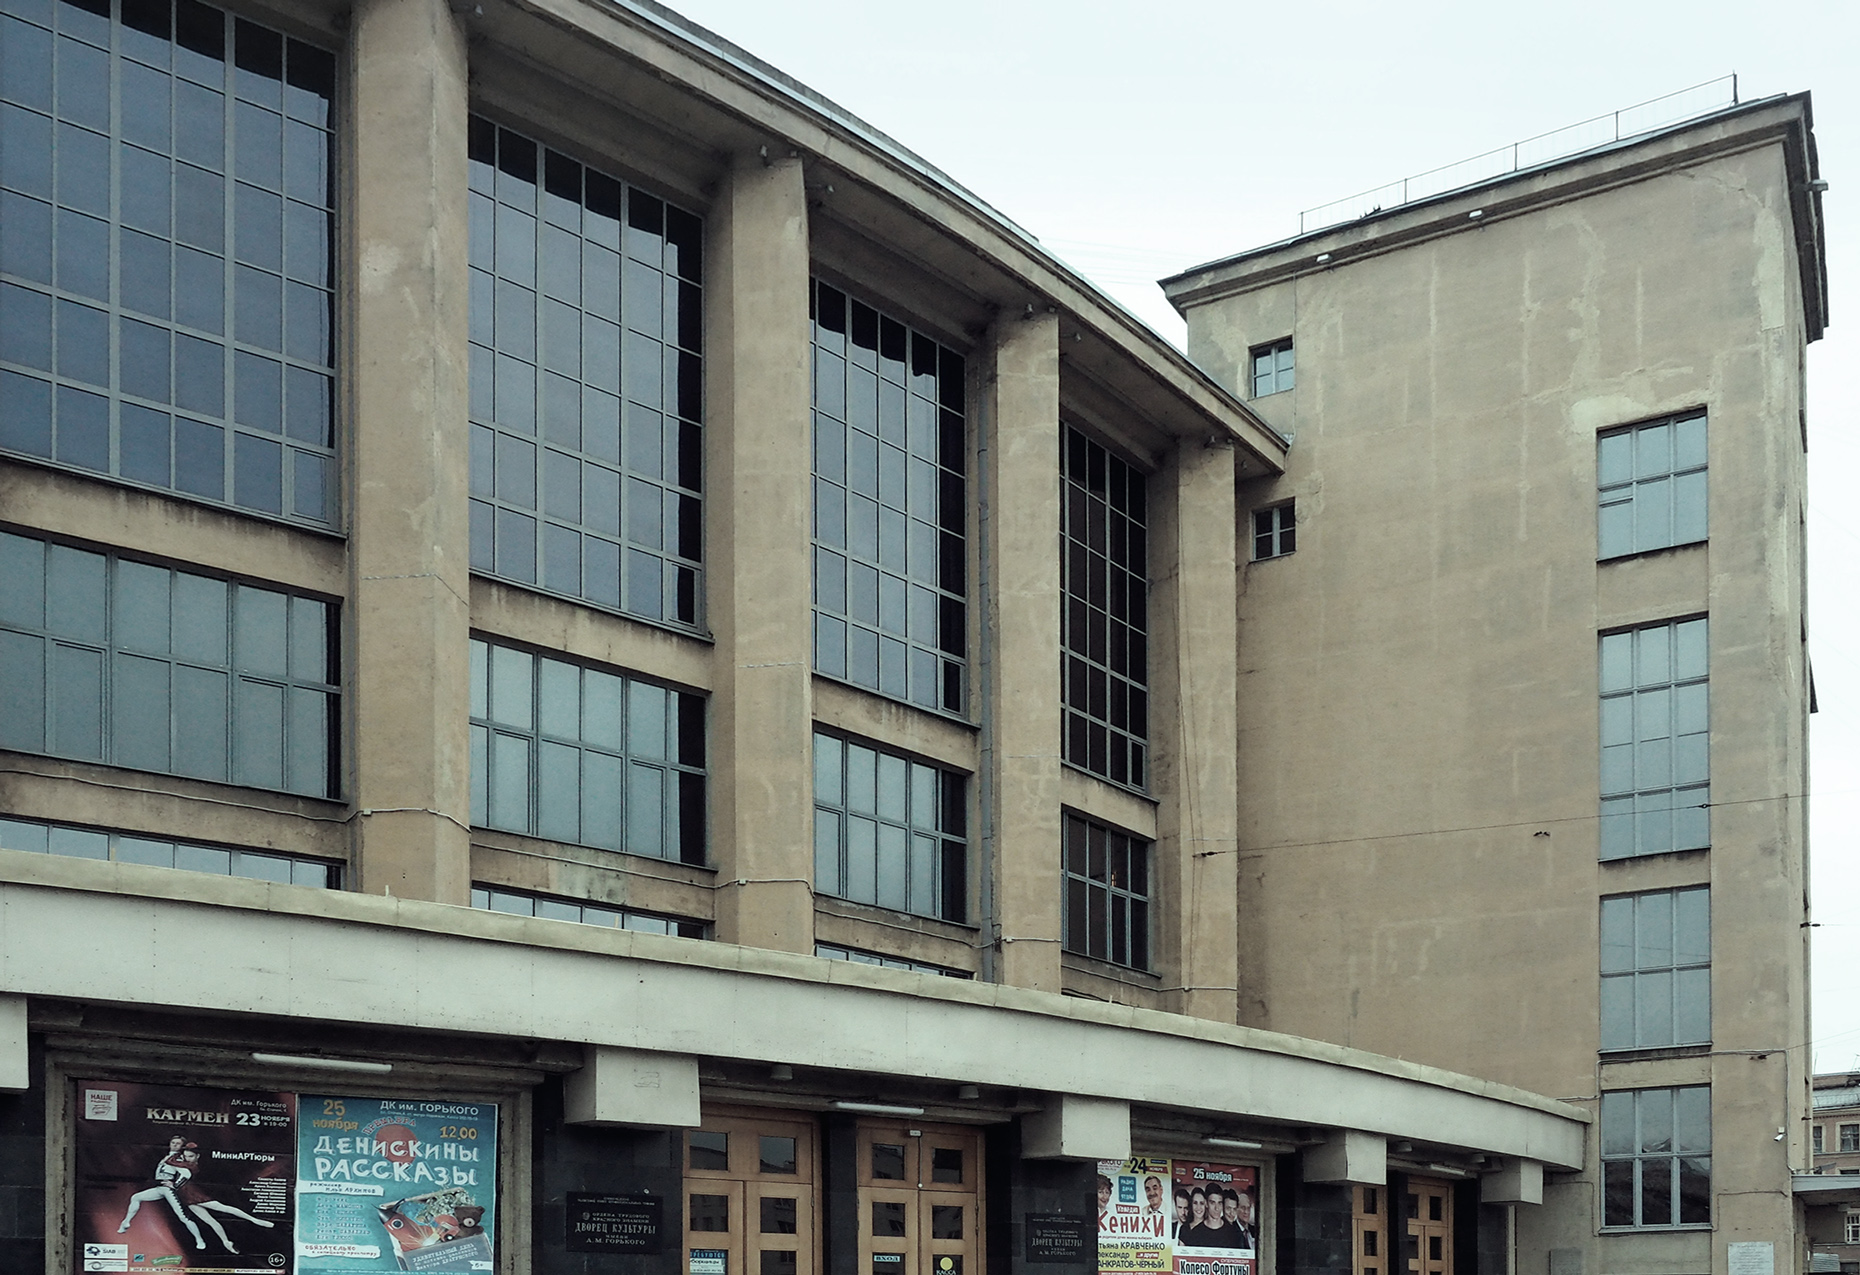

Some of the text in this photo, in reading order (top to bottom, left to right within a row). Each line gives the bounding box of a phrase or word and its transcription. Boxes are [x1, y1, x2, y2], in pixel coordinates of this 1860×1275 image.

[231, 1098, 241, 1106] ДК
[256, 1101, 287, 1109] Горького
[323, 1099, 346, 1116] 25
[380, 1101, 479, 1116] ДК им. ГОРЬКОГО
[146, 1108, 229, 1124] КАРМЕН
[236, 1112, 261, 1126] 23
[313, 1117, 359, 1132] ноября
[440, 1126, 478, 1140] 12.00
[212, 1151, 275, 1162] МиниАРТюры
[313, 1136, 480, 1162] ДЕНИСКИНЫ
[314, 1157, 479, 1186] РАССКАЗЫ
[1130, 1157, 1147, 1174] 24
[1193, 1167, 1205, 1180] 25
[1206, 1171, 1233, 1183] ноября
[575, 1222, 656, 1234] ДВОРЕЦ КУЛЬТУРЫ
[605, 1238, 646, 1246] ГОРЬКОГО
[1120, 1241, 1166, 1251] КРАВЧЕНКО
[270, 1256, 283, 1264] 16+
[1180, 1260, 1250, 1275] Колесо Фортуны
